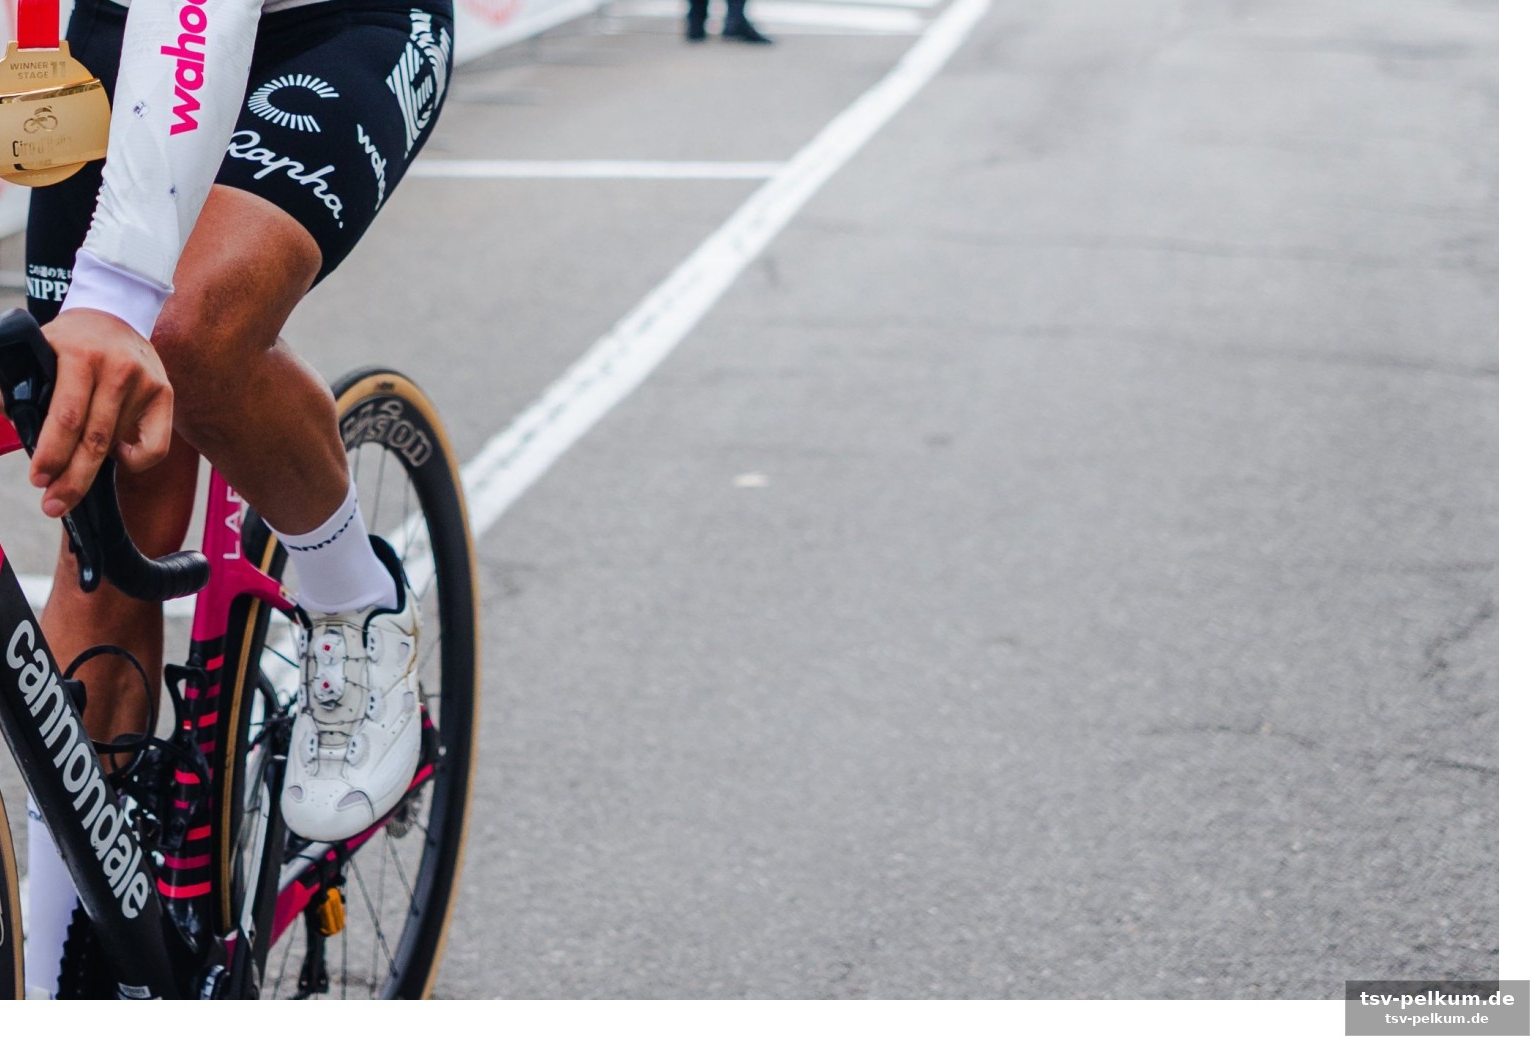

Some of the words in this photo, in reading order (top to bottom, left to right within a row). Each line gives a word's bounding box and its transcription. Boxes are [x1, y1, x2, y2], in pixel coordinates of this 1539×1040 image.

[10, 62, 48, 70] WINNER
[18, 71, 49, 79] STAGE
[26, 276, 70, 302] NIPP
[5, 618, 151, 920] cannondale
